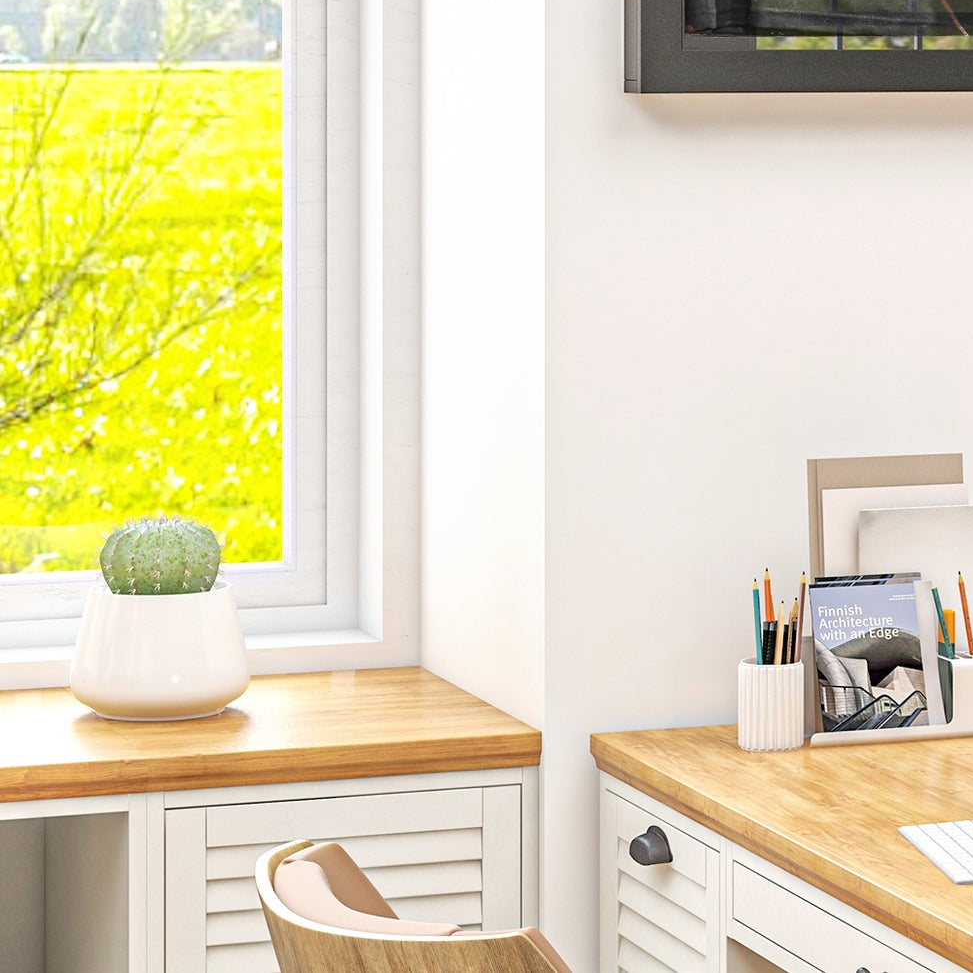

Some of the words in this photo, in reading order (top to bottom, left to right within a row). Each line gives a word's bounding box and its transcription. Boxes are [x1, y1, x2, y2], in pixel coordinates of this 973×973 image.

[818, 604, 862, 617] Finnish
[819, 617, 893, 629] Architecture
[820, 630, 846, 641] with
[850, 630, 866, 639] an
[869, 627, 899, 640] Edge
